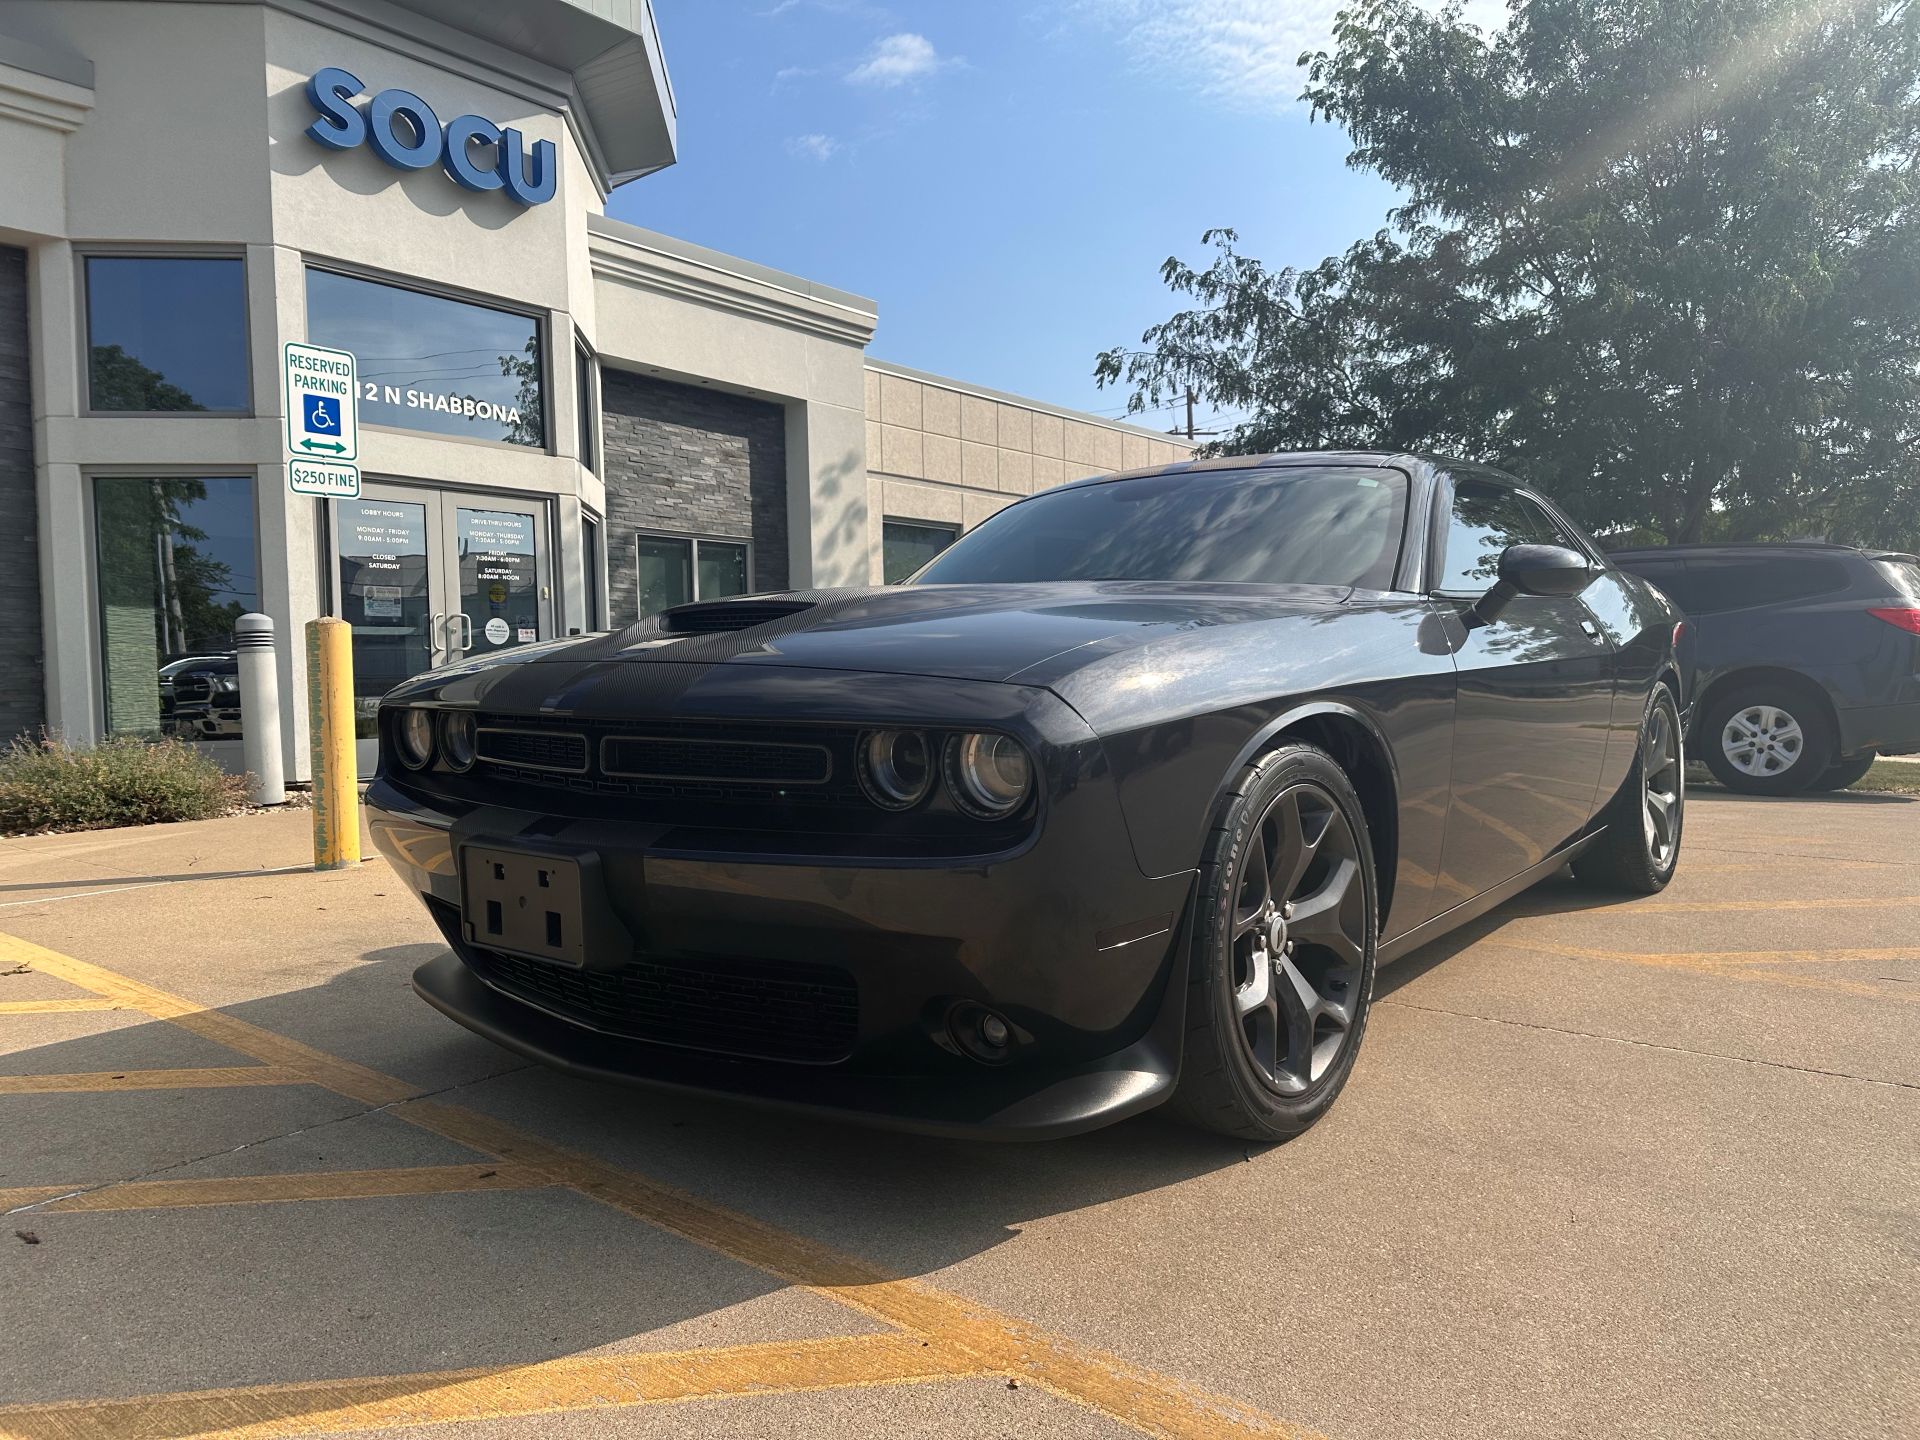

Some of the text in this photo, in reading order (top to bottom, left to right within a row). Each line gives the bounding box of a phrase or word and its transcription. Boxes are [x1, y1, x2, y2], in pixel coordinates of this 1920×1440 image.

[304, 67, 557, 207] SOCU
[289, 353, 350, 377] RESERVED
[294, 373, 347, 395] PARKING
[384, 385, 400, 405] N
[406, 389, 522, 425] SHABBONA
[294, 467, 355, 488] $250 FINE
[361, 508, 404, 518] LOBBY HOURS
[356, 526, 385, 534] MONDAY
[388, 528, 410, 536] FRIDAY
[469, 530, 494, 538] MONDAY
[496, 532, 525, 541] THURSDAY
[357, 534, 382, 543] 9:00AM
[386, 536, 409, 544] 5:00PM
[372, 553, 397, 561] CLOSED
[488, 549, 508, 557] FRIDAY
[368, 562, 401, 570] SATURDAY
[484, 567, 513, 575] SATURDAY
